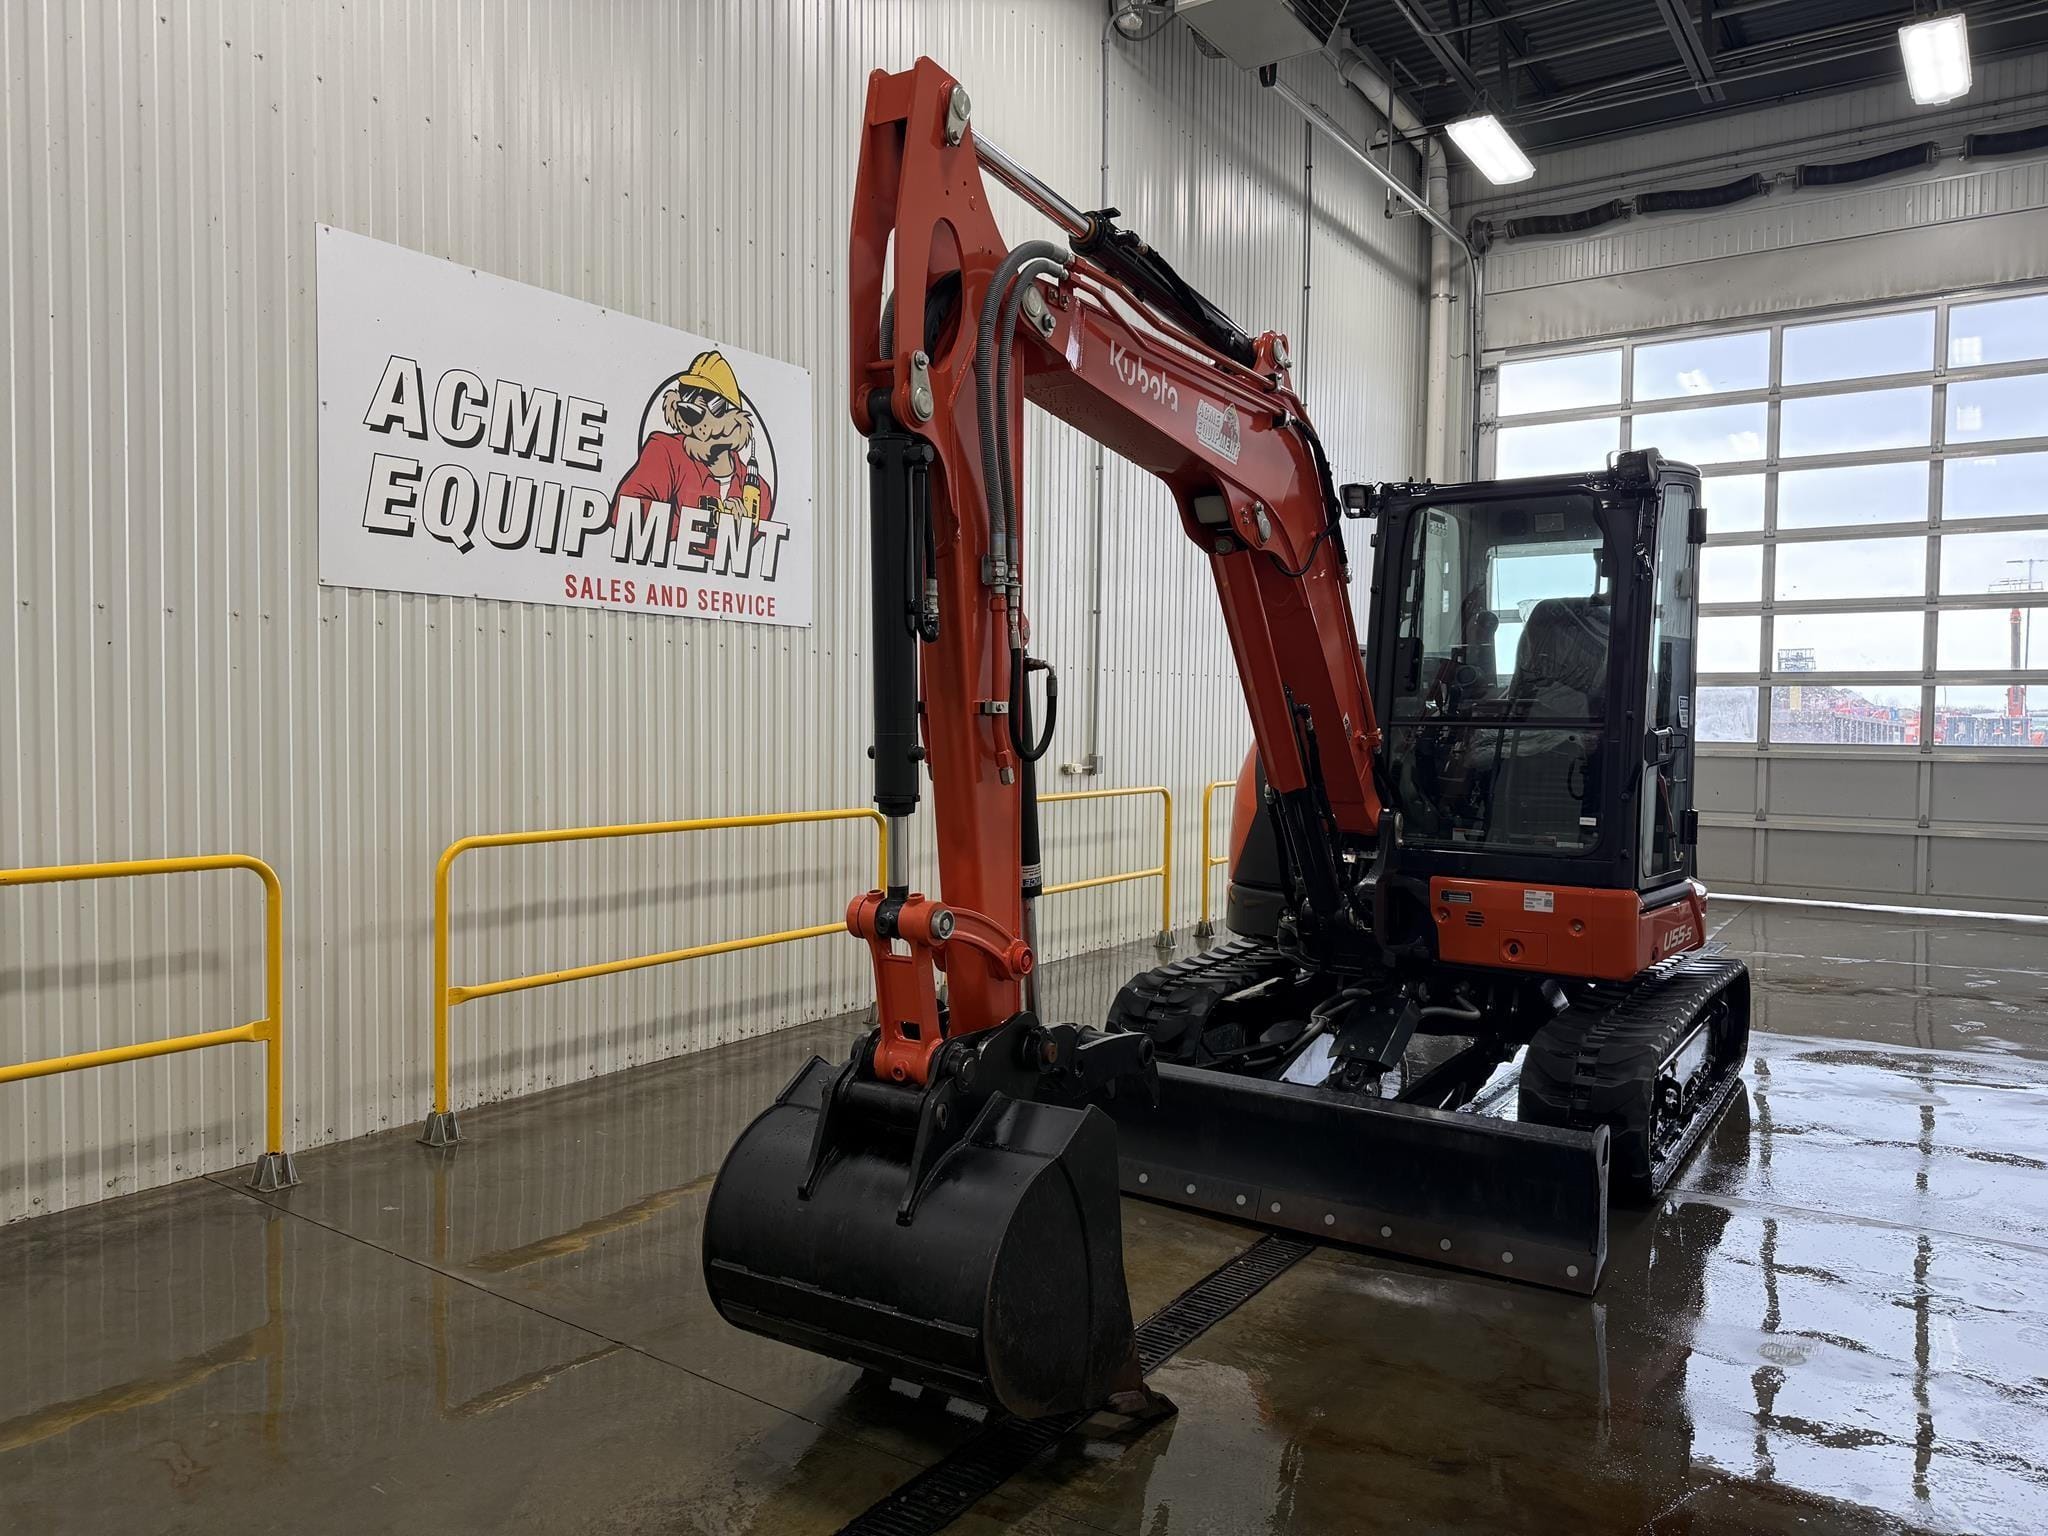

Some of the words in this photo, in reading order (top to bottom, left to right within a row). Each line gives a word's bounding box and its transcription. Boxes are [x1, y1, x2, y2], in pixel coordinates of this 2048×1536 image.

[1109, 339, 1178, 413] Kubota
[363, 354, 608, 472] ACME
[1197, 420, 1240, 459] EQUIPMENT
[1198, 401, 1223, 428] ACME
[362, 452, 790, 582] EQUIPMENT
[565, 574, 636, 604] SALES
[646, 583, 688, 609] AND
[698, 588, 776, 617] SERVICE
